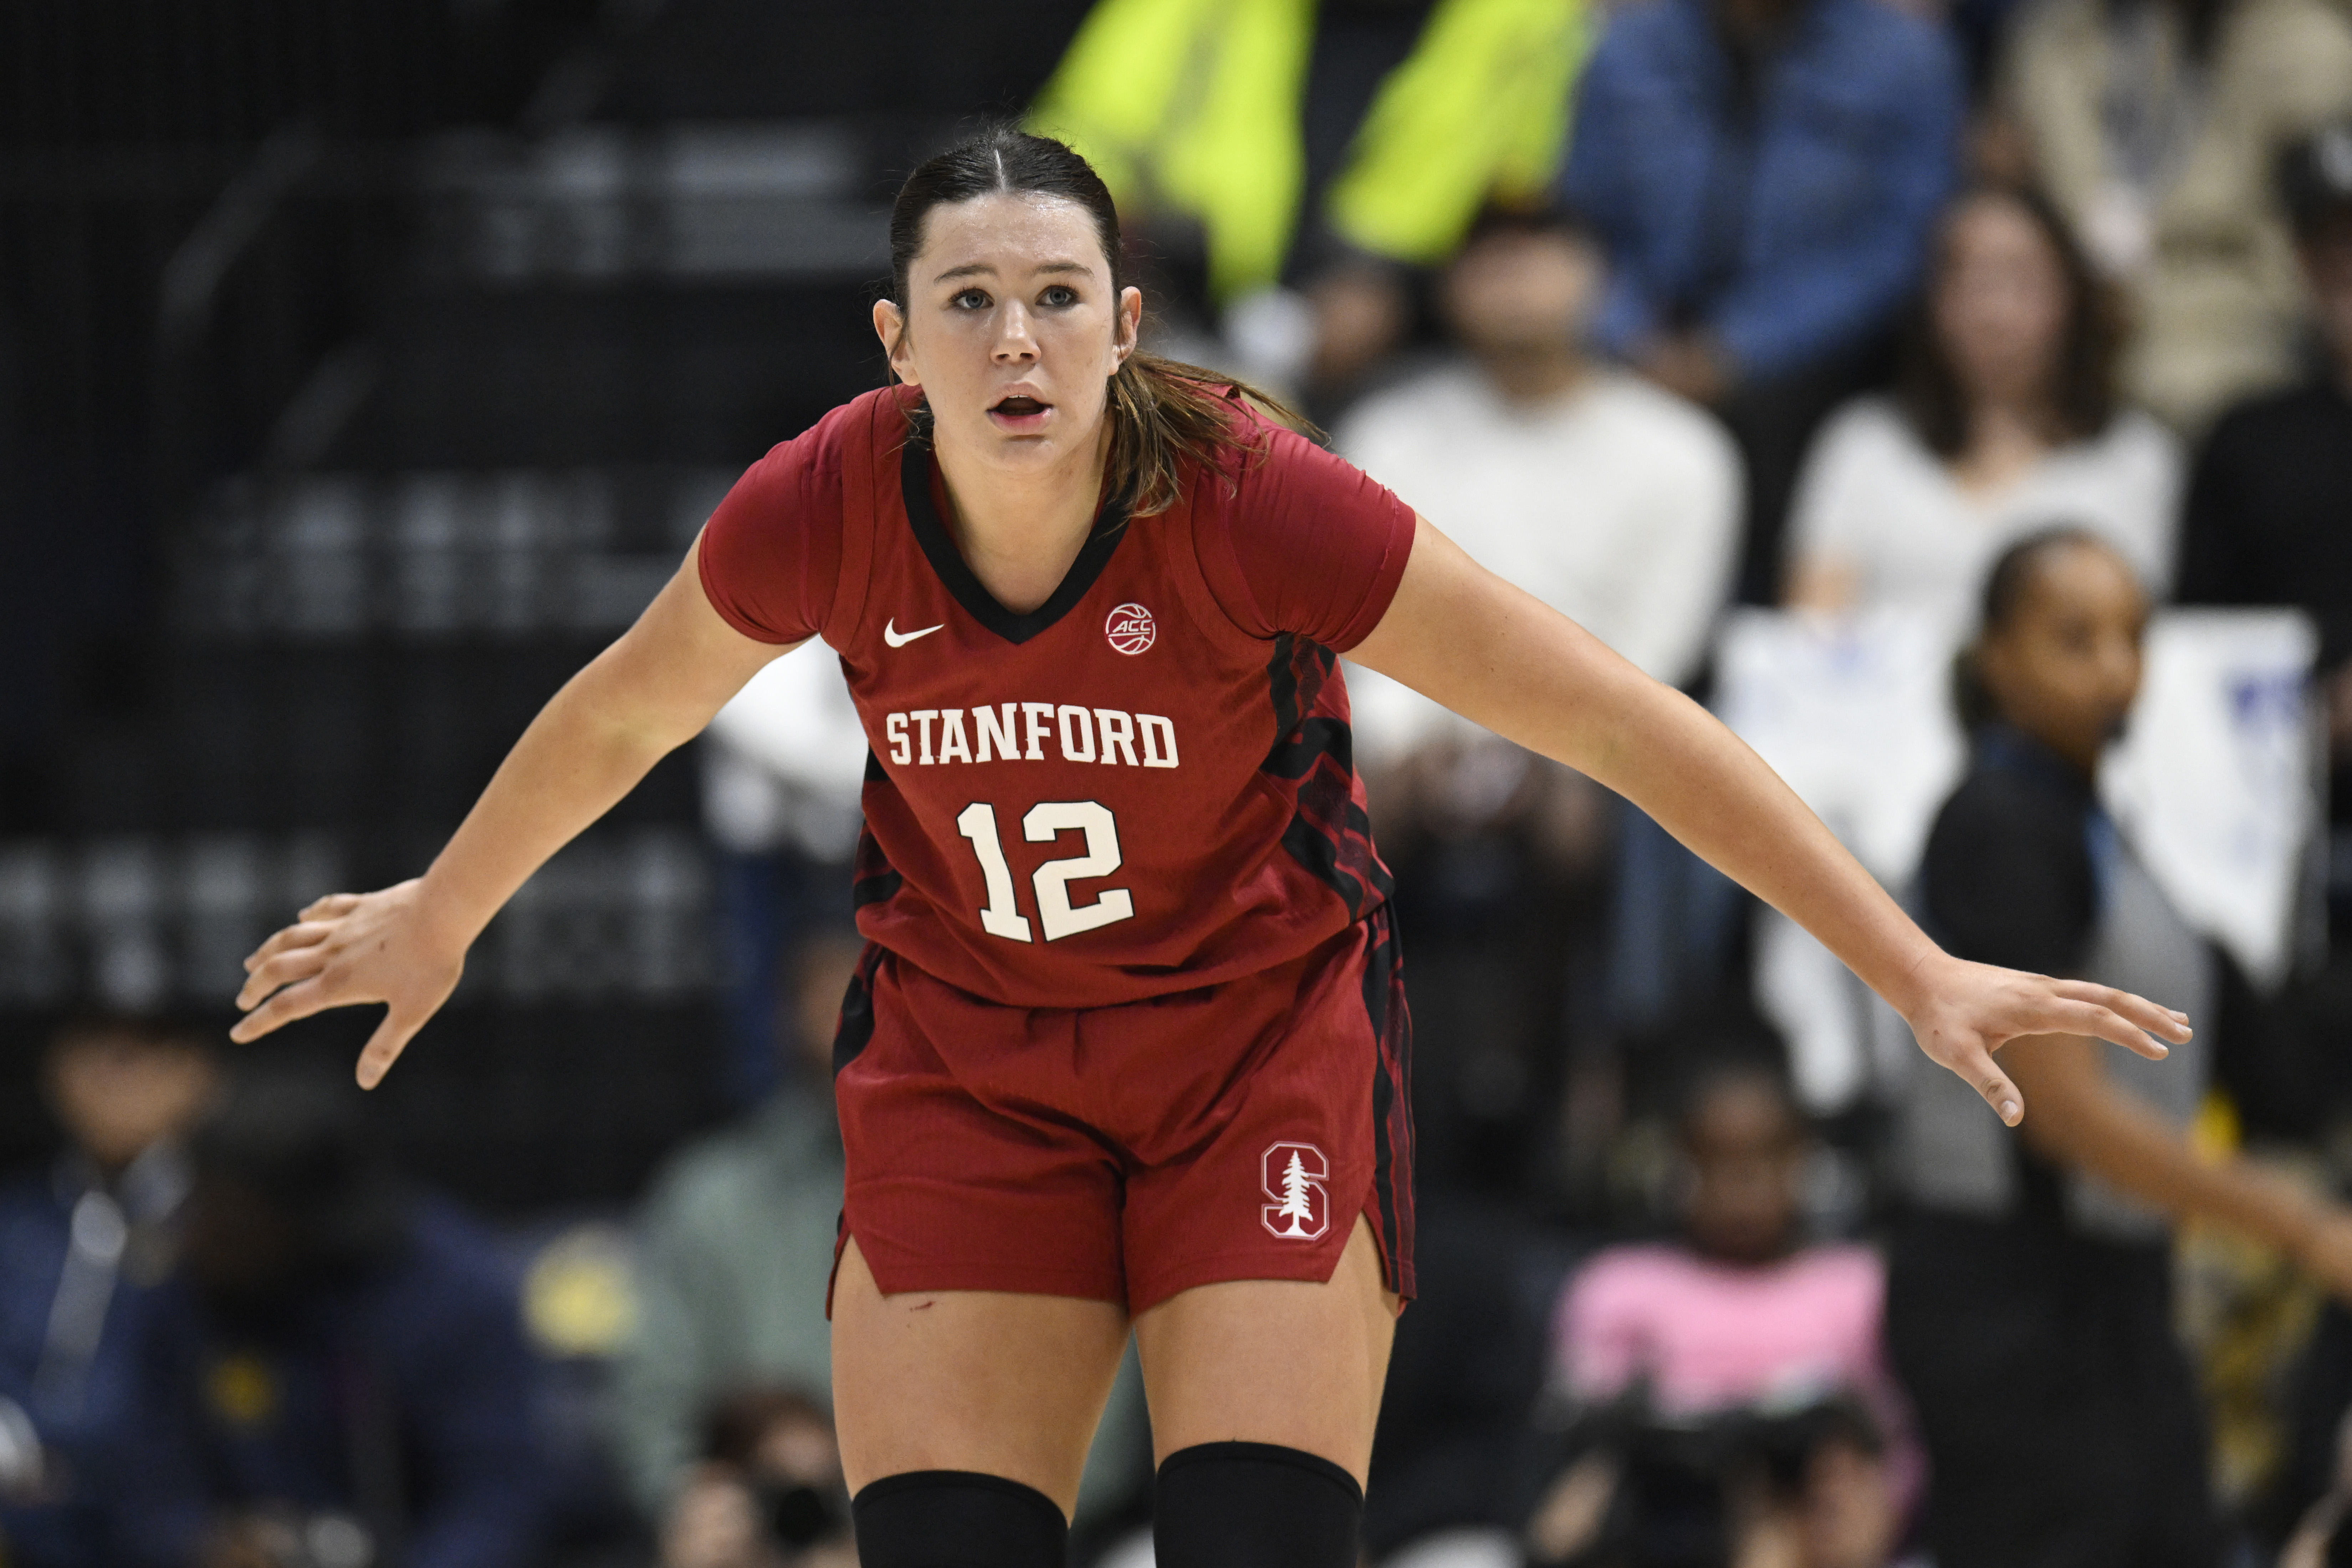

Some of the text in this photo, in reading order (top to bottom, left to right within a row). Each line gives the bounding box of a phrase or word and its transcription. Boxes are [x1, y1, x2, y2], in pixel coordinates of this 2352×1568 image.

[1113, 619, 1152, 632] ACC
[886, 702, 1179, 768] STANFORD
[956, 800, 1135, 943] 12
[1261, 1141, 1329, 1241] S
